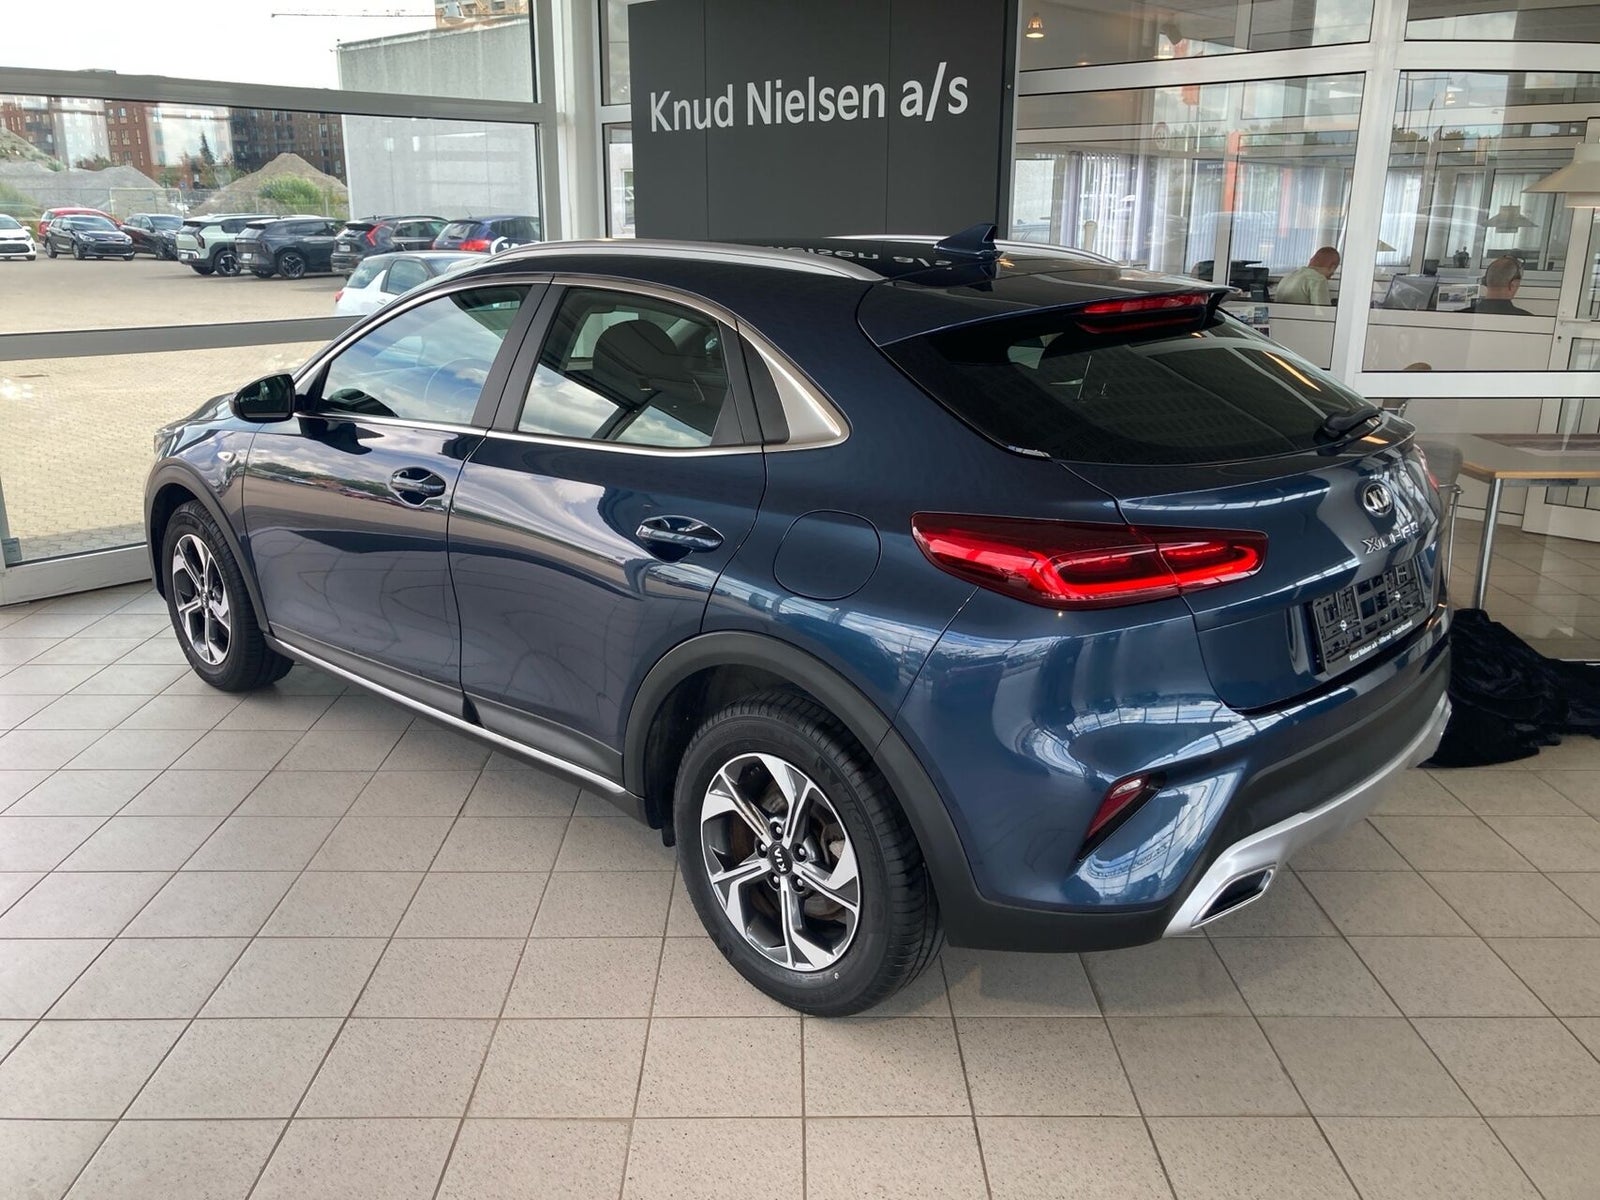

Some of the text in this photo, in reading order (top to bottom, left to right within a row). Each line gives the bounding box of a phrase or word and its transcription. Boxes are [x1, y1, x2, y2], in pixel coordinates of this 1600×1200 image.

[650, 61, 968, 132] Knud Nielsen a/s
[774, 848, 787, 872] KIA
